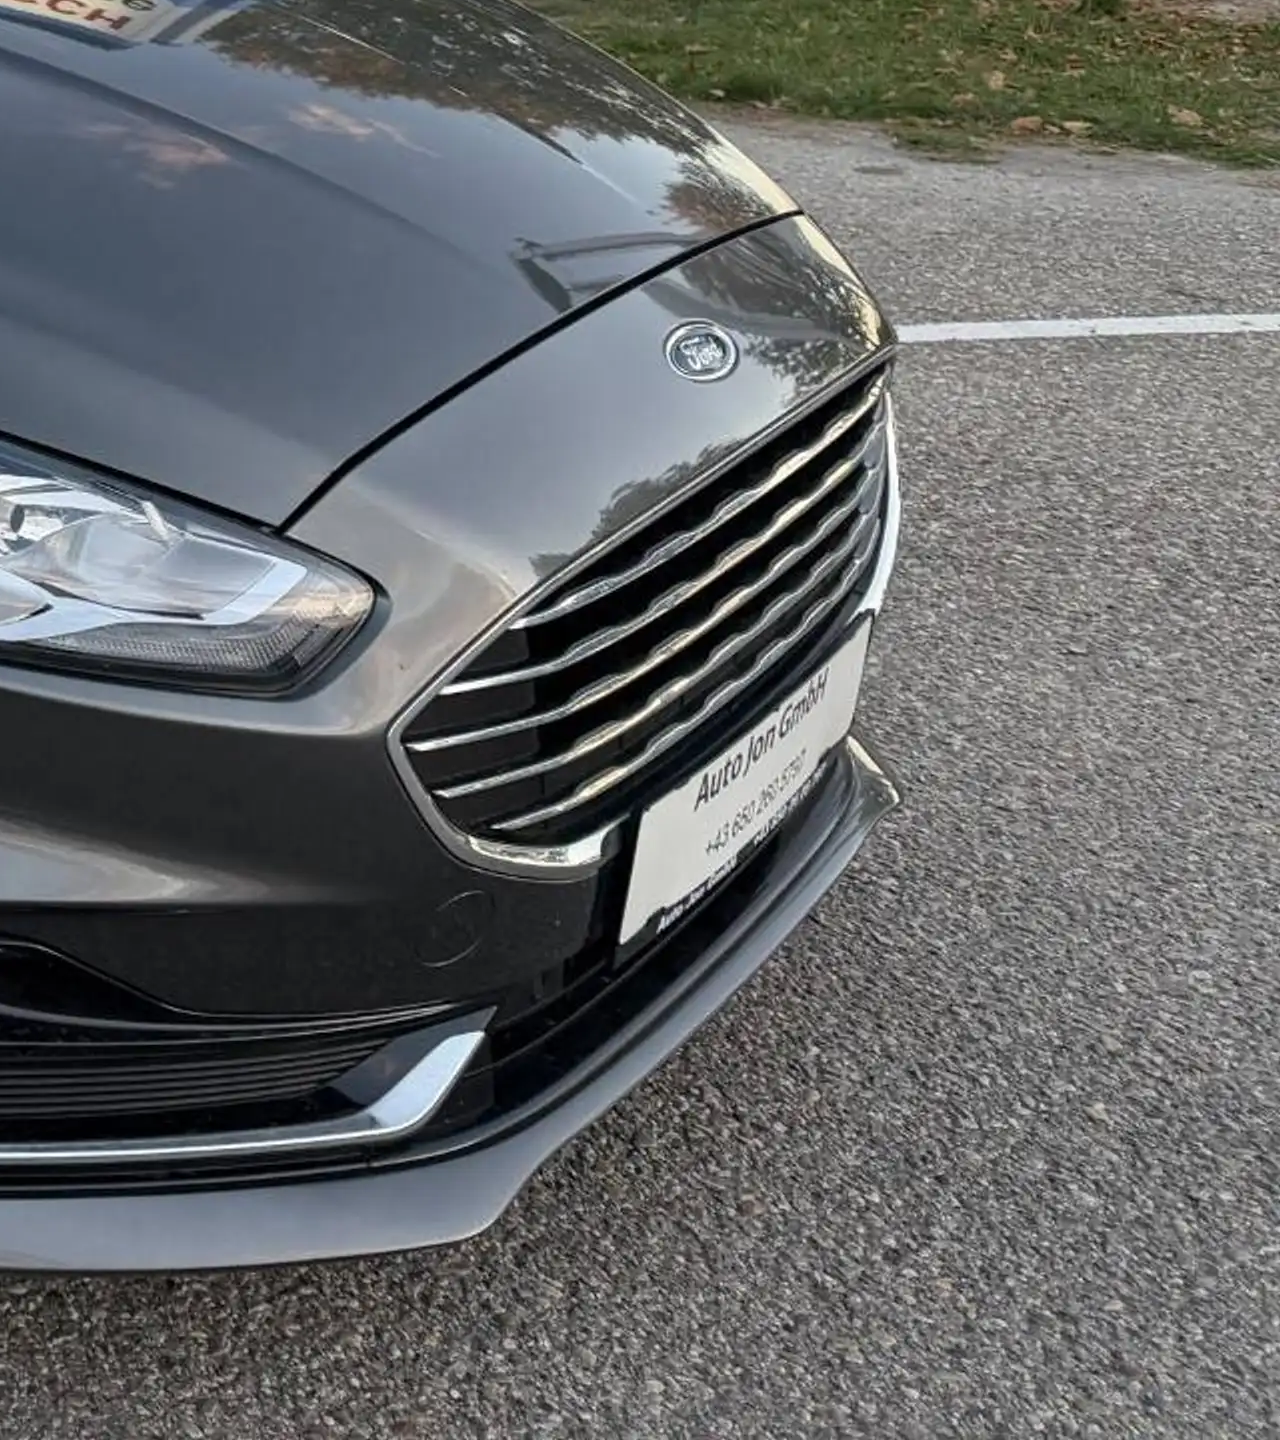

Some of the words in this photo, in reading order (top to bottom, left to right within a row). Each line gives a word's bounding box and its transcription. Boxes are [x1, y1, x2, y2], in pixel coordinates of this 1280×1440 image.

[693, 752, 743, 812] Auto
[743, 726, 776, 778] Jon
[778, 666, 830, 741] GmbH
